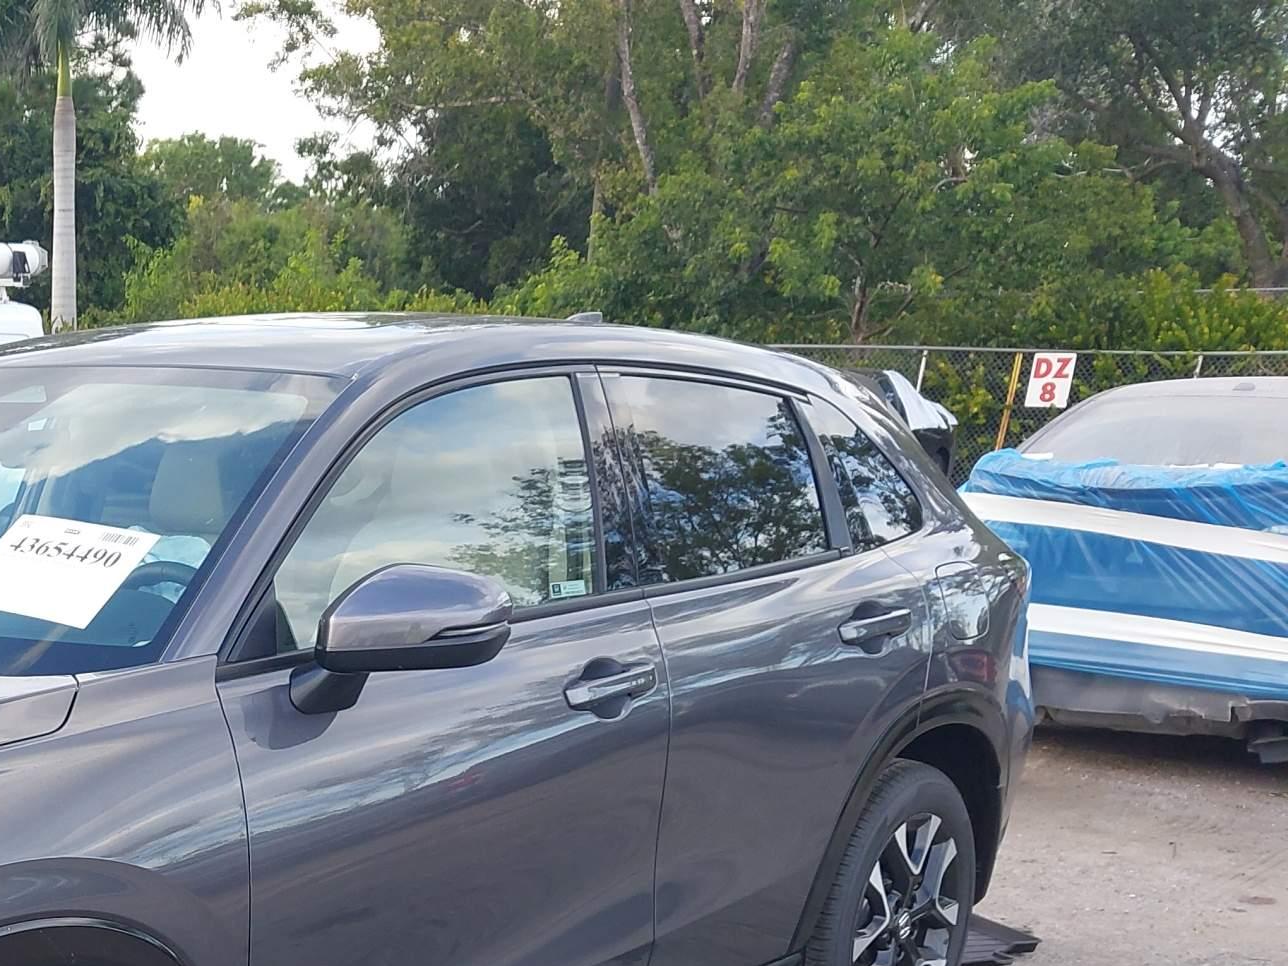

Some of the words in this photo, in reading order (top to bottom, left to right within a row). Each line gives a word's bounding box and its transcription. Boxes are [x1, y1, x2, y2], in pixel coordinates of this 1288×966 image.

[1033, 357, 1073, 379] DZ
[1039, 382, 1056, 402] 8
[10, 536, 122, 568] 43654490
